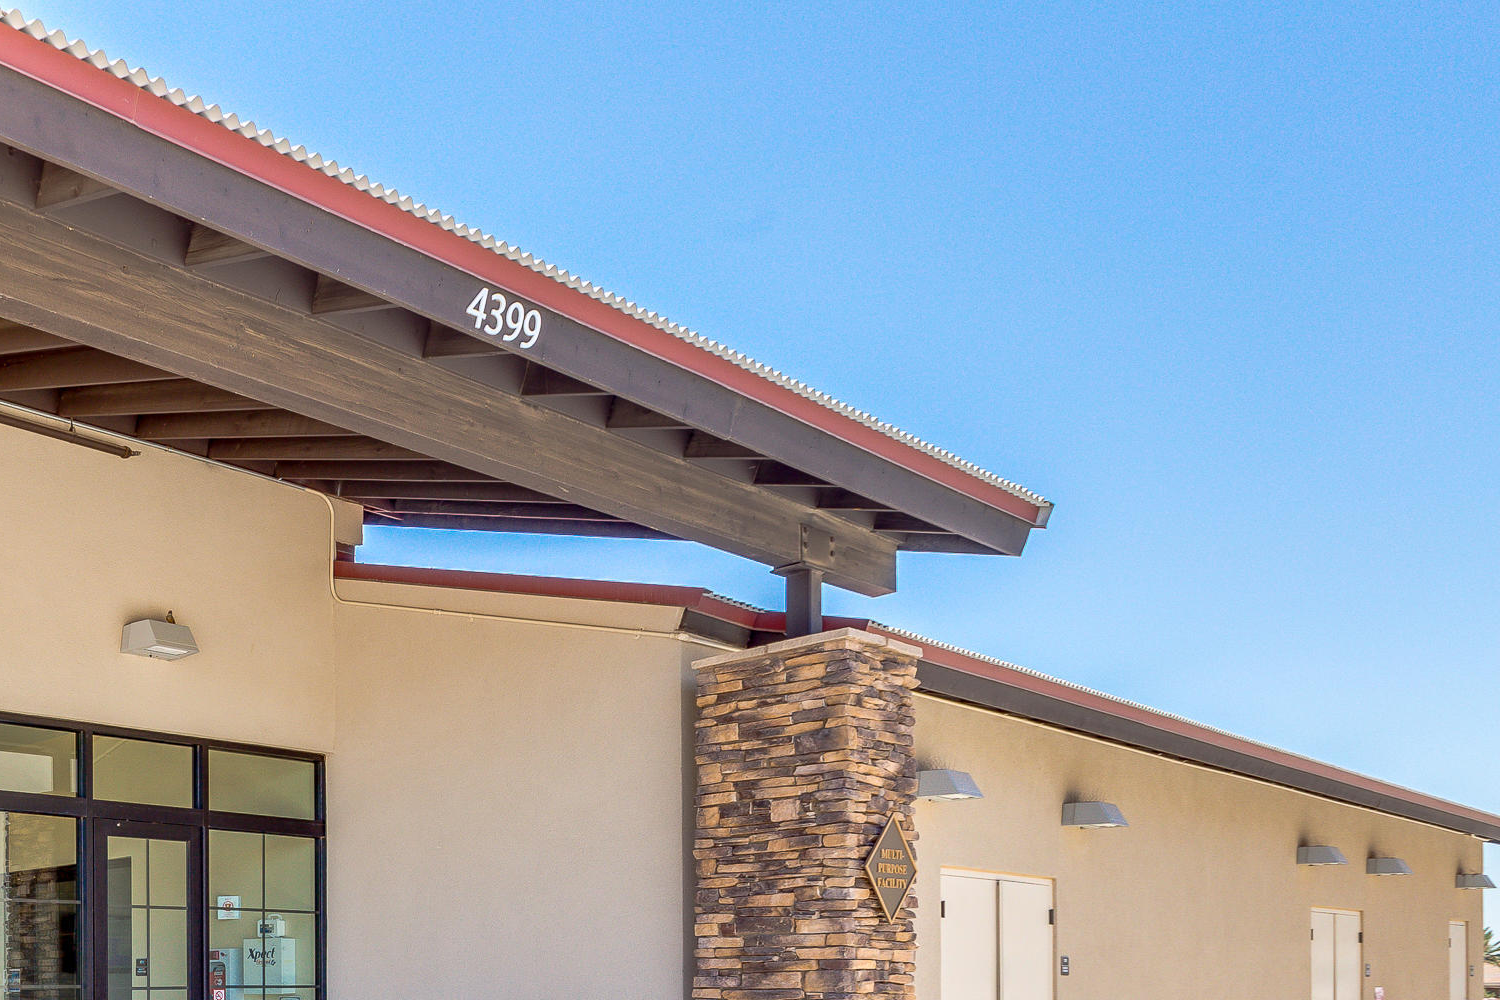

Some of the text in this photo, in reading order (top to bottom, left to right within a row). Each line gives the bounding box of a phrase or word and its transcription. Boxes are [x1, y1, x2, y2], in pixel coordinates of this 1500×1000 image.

[465, 287, 542, 349] 4399
[880, 848, 905, 860] MULTI-
[877, 863, 908, 875] PURPOSE
[876, 877, 908, 889] FACILITY
